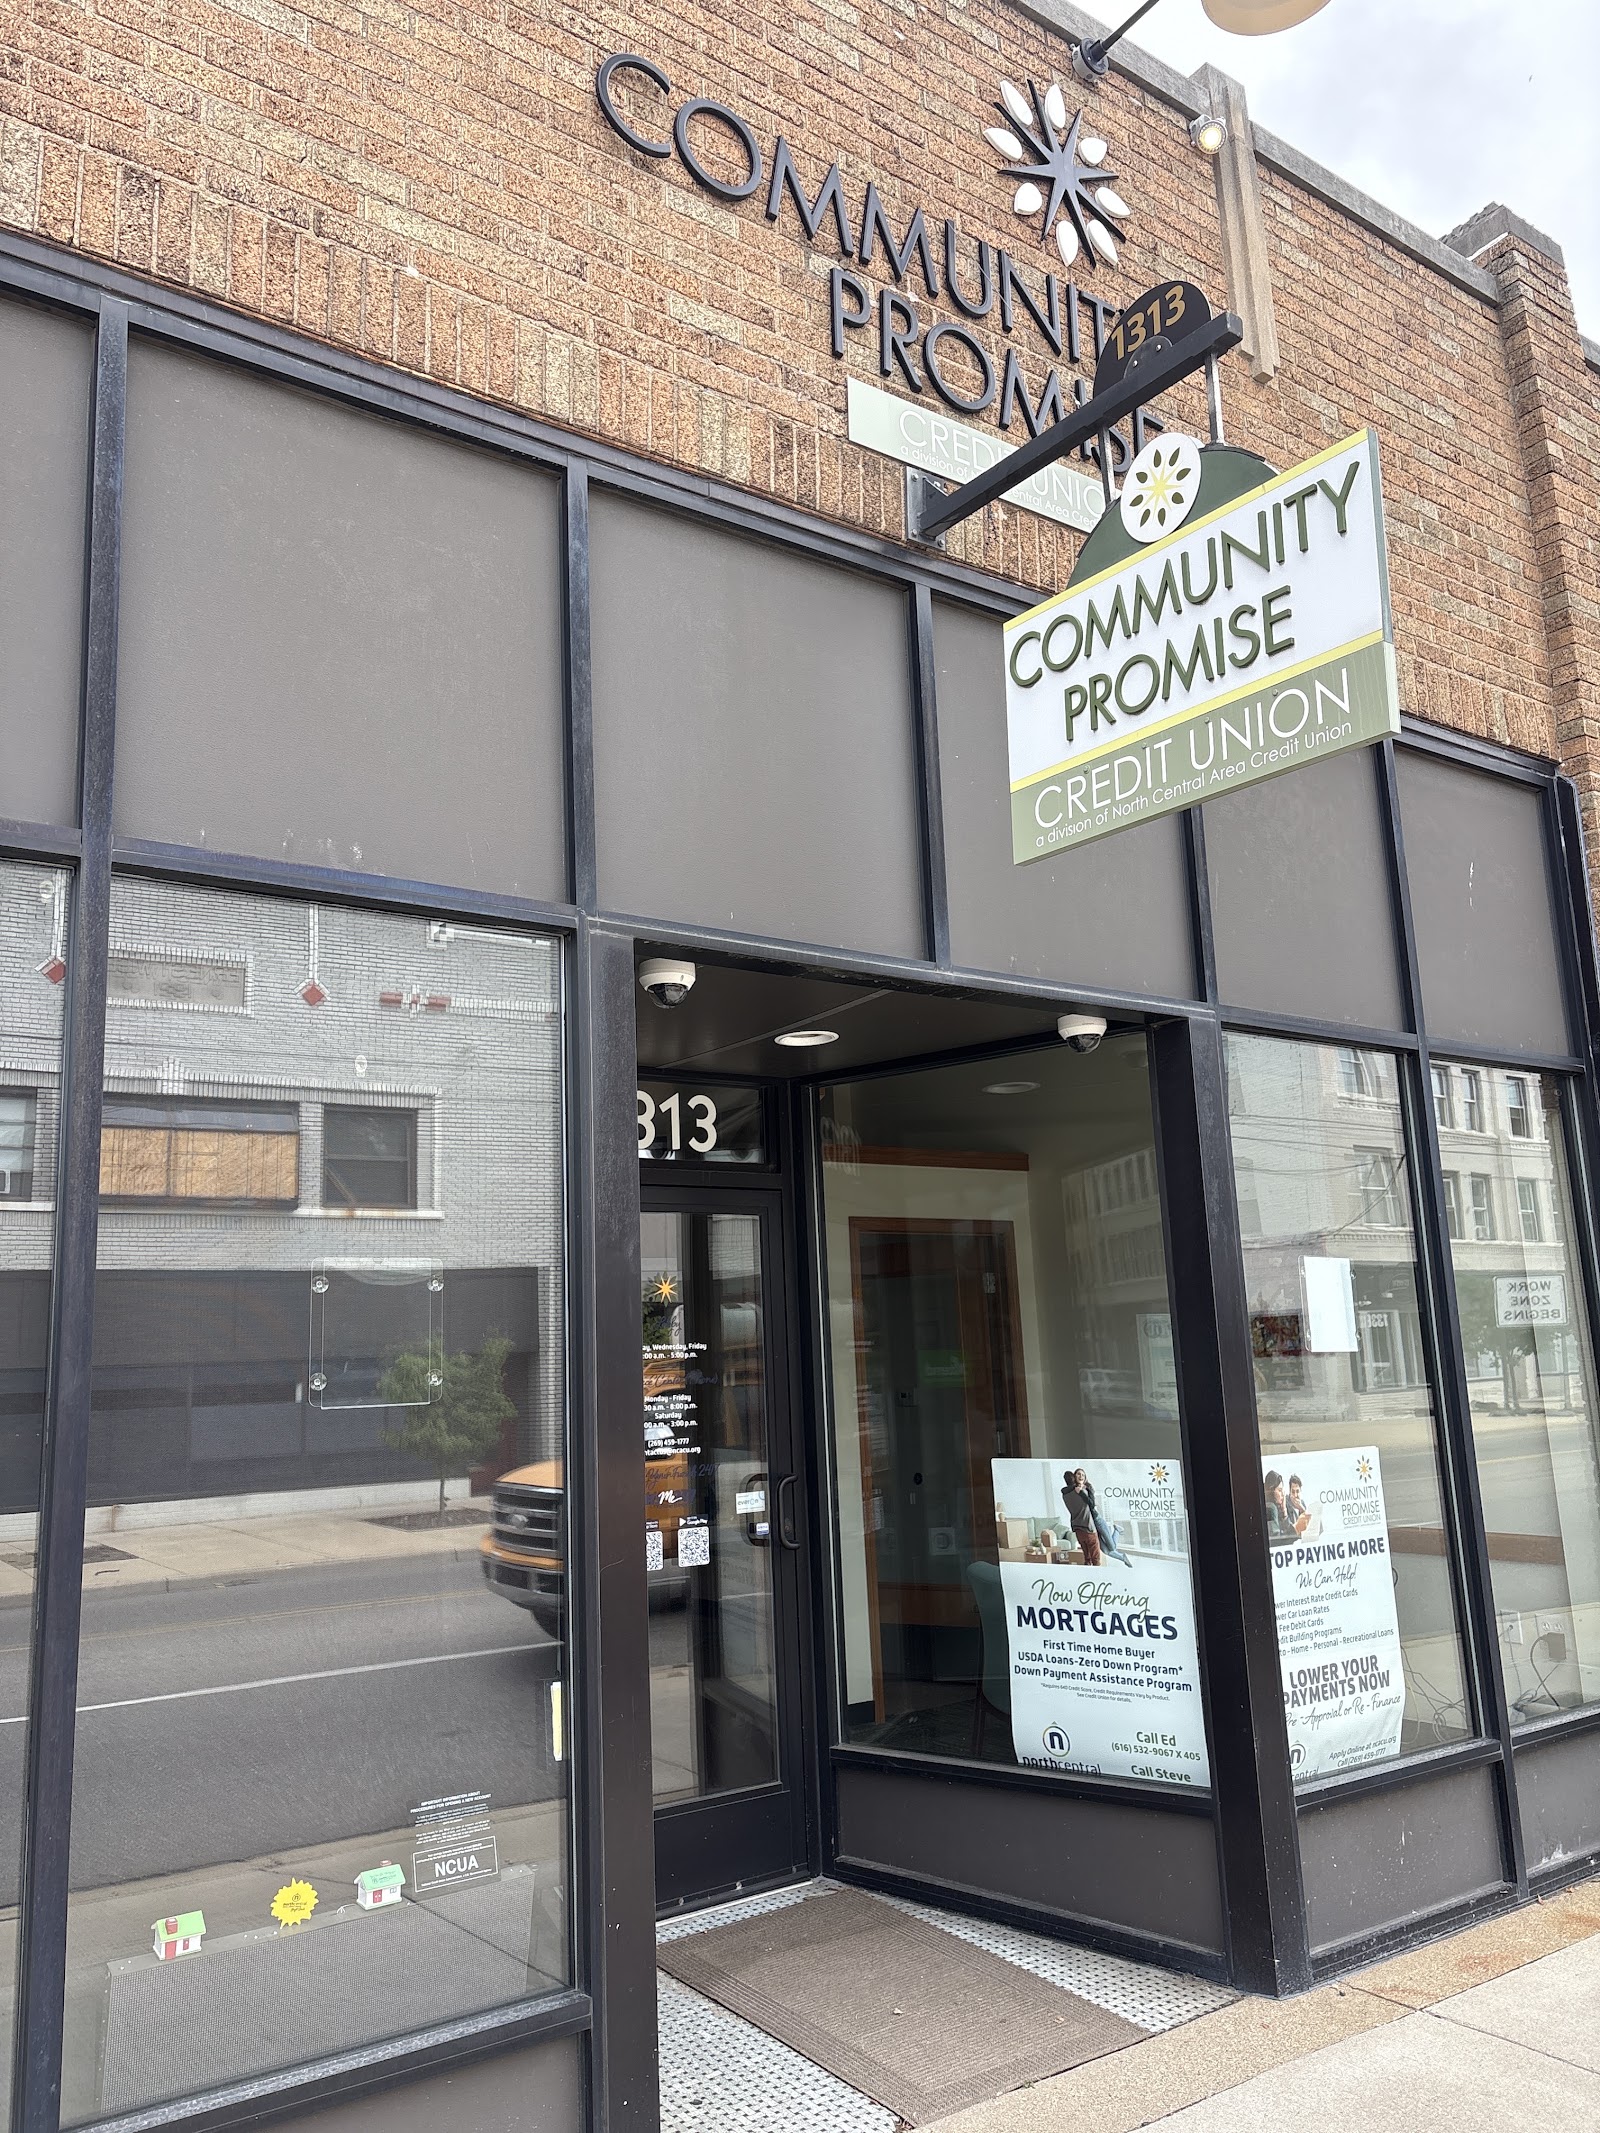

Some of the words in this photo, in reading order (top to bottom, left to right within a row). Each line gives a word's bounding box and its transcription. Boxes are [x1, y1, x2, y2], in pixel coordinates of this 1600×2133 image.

[596, 53, 1124, 364] COMMUNIT
[1111, 285, 1186, 360] 1313
[901, 445, 909, 455] a
[912, 447, 954, 475] division
[957, 467, 968, 478] of
[1045, 500, 1069, 518] Area
[1010, 461, 1360, 688] COMMUNITY
[1064, 584, 1295, 742] PROMISE
[1034, 738, 1173, 828] CREDIT
[1189, 667, 1351, 771] UNION
[1036, 836, 1045, 848] a
[1048, 819, 1092, 842] division
[1096, 810, 1110, 826] of
[1112, 796, 1149, 820] North
[1152, 772, 1206, 805] Central
[1210, 761, 1247, 782] Area
[1250, 740, 1301, 769] Credit
[1304, 721, 1353, 749] Union
[672, 1394, 692, 1402] Friday
[654, 1412, 682, 1420] Saturday
[684, 1420, 698, 1428] p.m.
[1104, 1487, 1175, 1499] COMMUNITY
[1320, 1485, 1379, 1504] COMMUNITY
[1128, 1500, 1176, 1511] PROMISE
[1130, 1510, 1152, 1518] CREDIT
[1342, 1500, 1381, 1518] PROMISE
[1342, 1516, 1362, 1526] CREDIT
[1362, 1514, 1381, 1523] UNION
[1296, 1543, 1345, 1566] PAYING
[1348, 1537, 1385, 1558] MORE
[1296, 1571, 1312, 1589] We
[1314, 1569, 1333, 1589] Can
[1334, 1562, 1358, 1588] Help!
[1032, 1579, 1073, 1605] Now
[1077, 1581, 1150, 1623] Offering
[1286, 1598, 1310, 1608] Interest
[1311, 1594, 1324, 1604] Rate
[1325, 1591, 1341, 1602] Credit
[1342, 1588, 1359, 1598] Cards
[1288, 1610, 1297, 1620] Car
[1298, 1608, 1313, 1618] Loan
[1314, 1605, 1330, 1615] Rates
[1017, 1605, 1178, 1641] MORTGAGES
[1279, 1624, 1290, 1633] Fee
[1290, 1620, 1307, 1631] Debit
[1308, 1617, 1324, 1628] Cards
[1278, 1635, 1289, 1645] dit
[1290, 1631, 1314, 1643] Building
[1314, 1626, 1343, 1639] Programs
[1291, 1644, 1309, 1655] Home
[1314, 1638, 1339, 1651] Personal
[1342, 1630, 1378, 1644] Recreational
[1378, 1628, 1394, 1639] Loans
[1044, 1640, 1066, 1651] First
[1067, 1642, 1092, 1653] Time
[1094, 1644, 1123, 1656] Home
[1126, 1647, 1155, 1660] Buyer
[1018, 1652, 1044, 1663] USDA
[1046, 1654, 1101, 1668] Loans-Zero
[1103, 1660, 1132, 1671] Down
[1014, 1665, 1041, 1676] Down
[1044, 1668, 1087, 1681] Payment
[1090, 1672, 1145, 1687] Assistance
[1146, 1678, 1192, 1692] Program
[1290, 1662, 1339, 1689] LOWER
[1341, 1654, 1379, 1678] YOUR
[1358, 1670, 1390, 1693] NOW
[1106, 1689, 1135, 1697] Requirements
[1344, 1706, 1352, 1715] or
[1352, 1696, 1365, 1715] Re
[1371, 1692, 1401, 1711] Finance
[1136, 1732, 1159, 1745] Call
[1161, 1734, 1177, 1747] Ed
[1112, 1742, 1132, 1754] (616)
[1134, 1745, 1174, 1758] 532-9067
[1176, 1750, 1183, 1759] X
[1184, 1751, 1201, 1761] 405
[1330, 1750, 1347, 1761] Apply
[1347, 1746, 1365, 1756] Online
[1365, 1743, 1372, 1751] at
[1338, 1758, 1349, 1768] Call
[1132, 1765, 1154, 1778] Call
[1156, 1769, 1191, 1783] Steve
[434, 1854, 479, 1878] NCUA
